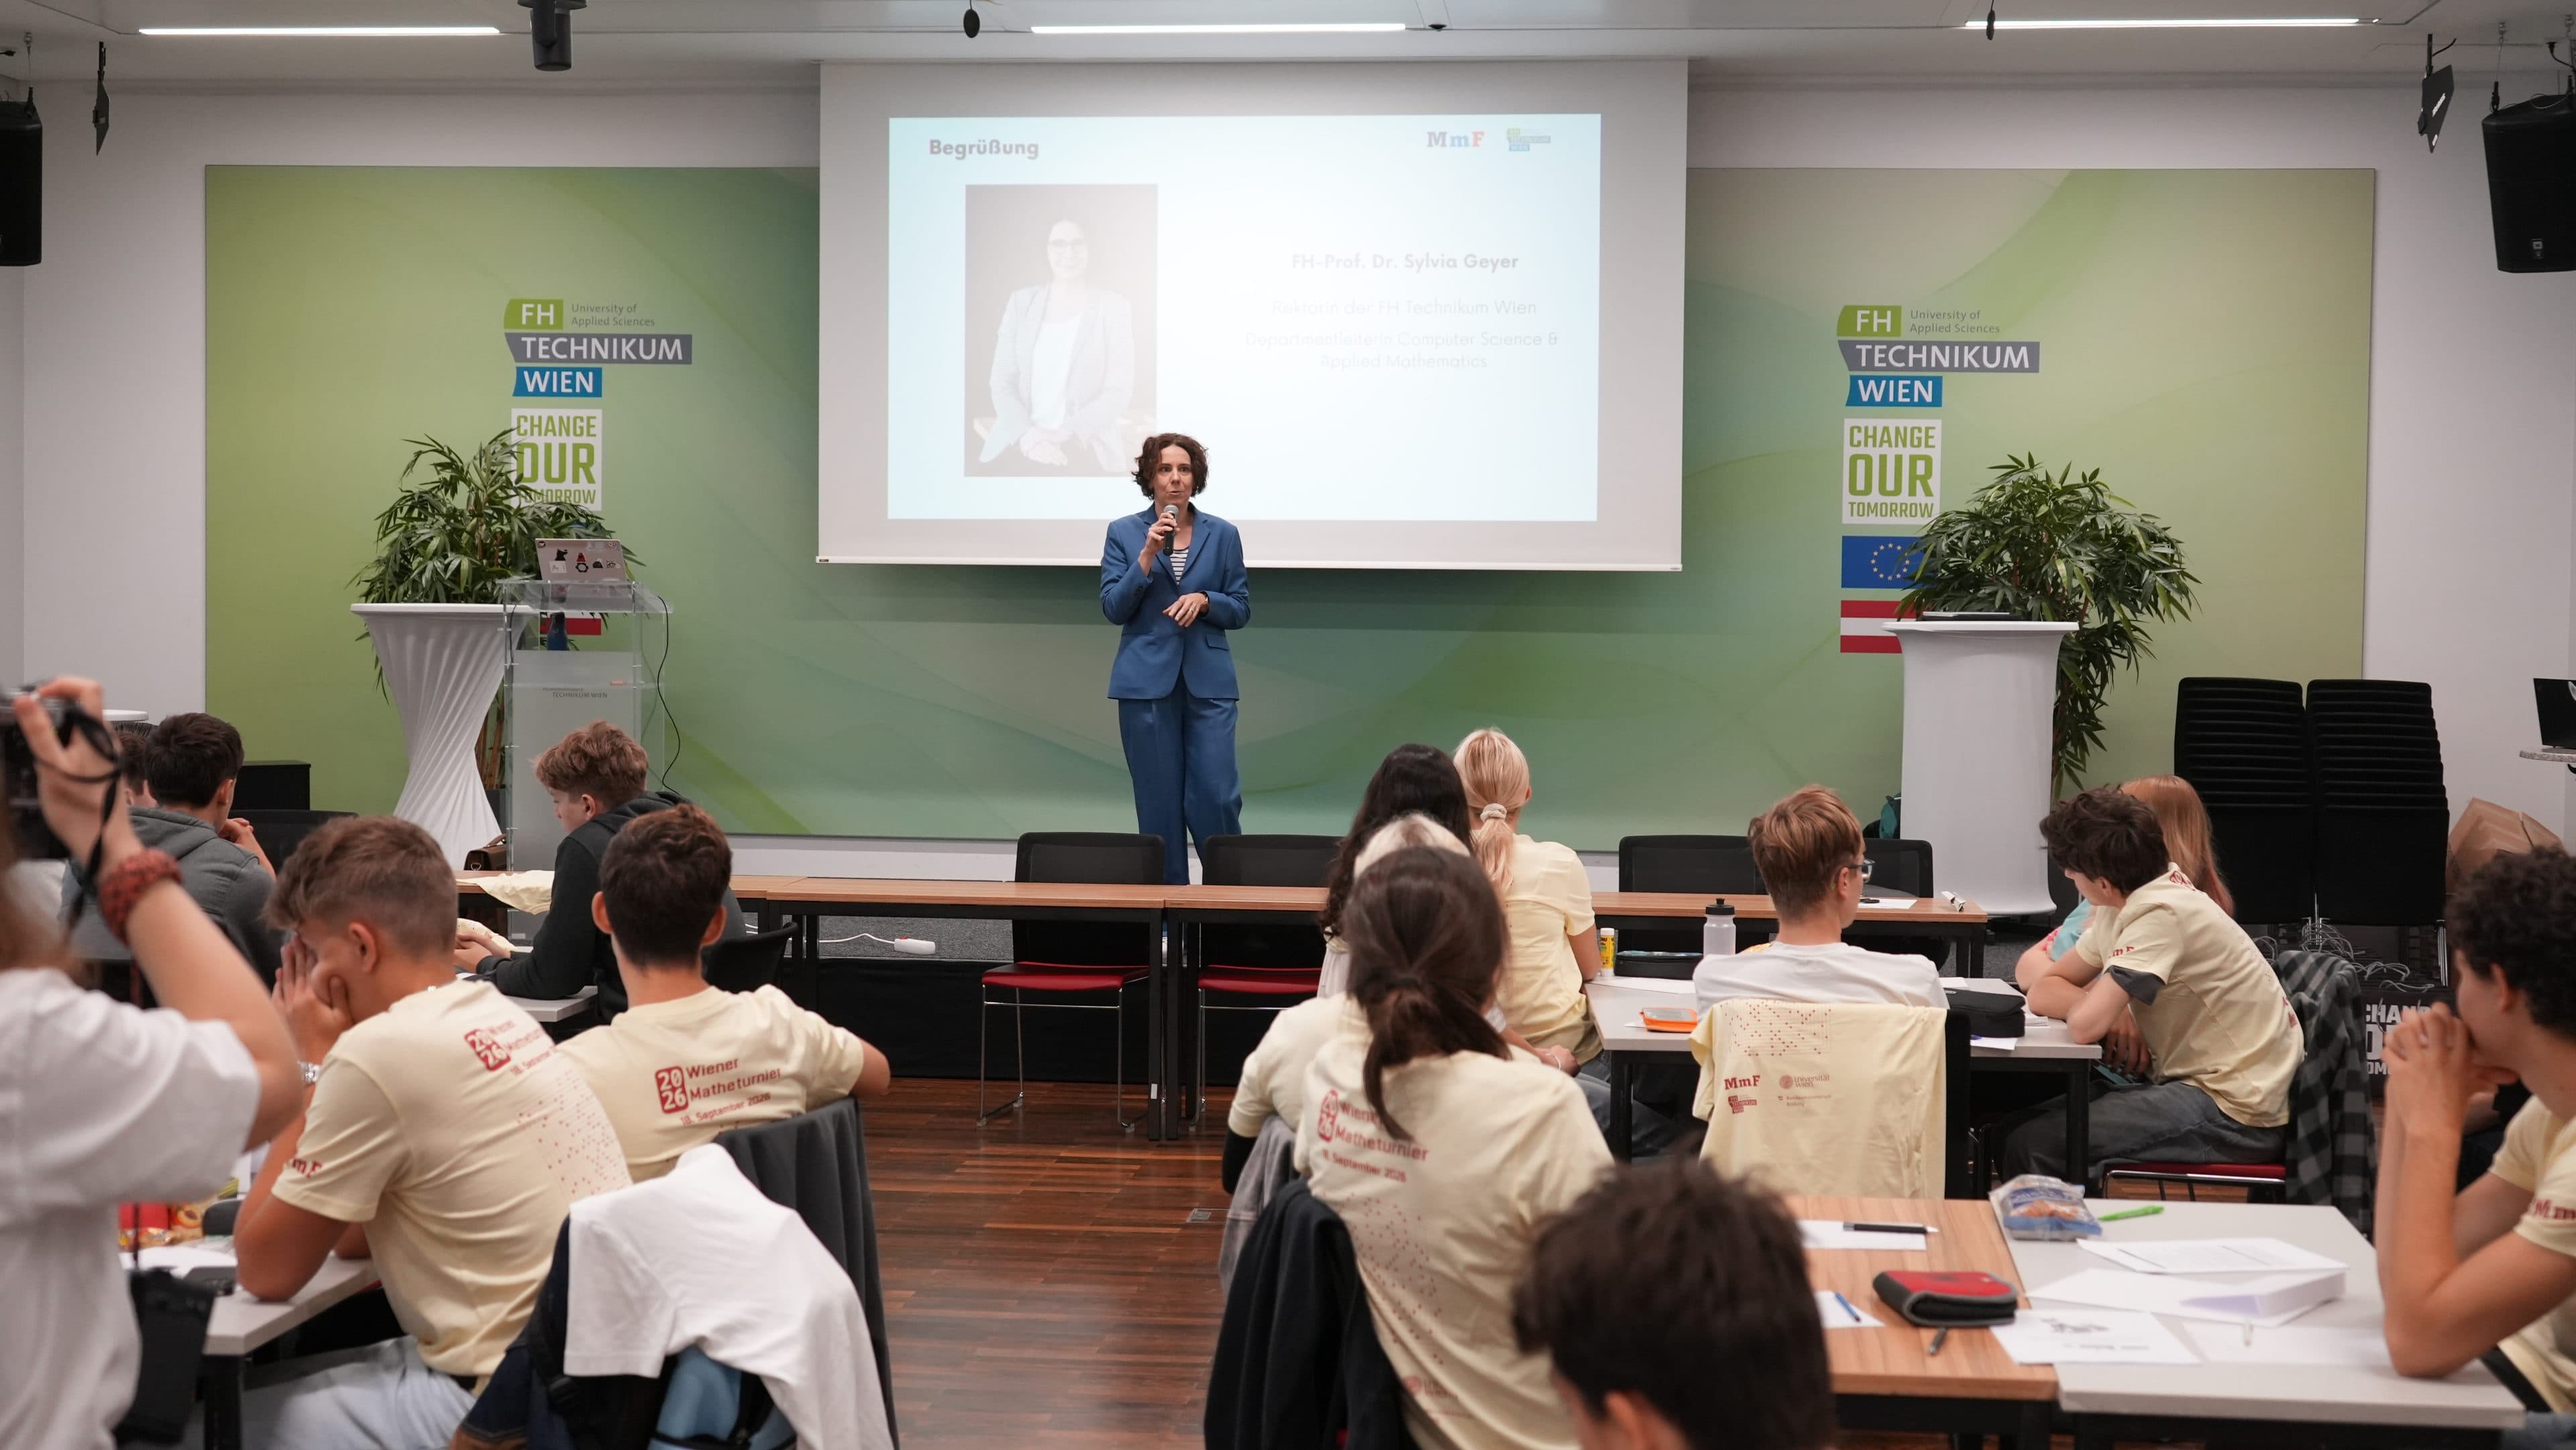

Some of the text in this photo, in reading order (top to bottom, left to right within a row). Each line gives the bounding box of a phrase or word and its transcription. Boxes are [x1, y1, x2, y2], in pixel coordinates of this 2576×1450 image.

[929, 139, 1039, 160] Begrüßung
[1427, 131, 1485, 148] MmF
[1291, 252, 1519, 273] FH-Prof. Dr. Sylvia Geyer
[521, 303, 554, 325] FH
[572, 303, 637, 314] University of
[1379, 300, 1400, 314] FH
[1406, 295, 1489, 314] Technikum
[1495, 299, 1538, 314] Wien
[1911, 309, 1981, 321] University of
[571, 316, 655, 328] Applied Sciences
[1856, 310, 1892, 333] FH
[1910, 323, 2000, 335] Applied Sciences
[521, 337, 683, 360] TECHNIKUM
[1397, 331, 1476, 348] Computer
[1481, 331, 1543, 346] Science
[1548, 331, 1558, 346] &
[1387, 352, 1487, 368] Mathematics
[1856, 344, 2029, 368] TECHNIKUM
[523, 370, 593, 393] WIEN
[1858, 379, 1933, 403] WIEN
[517, 415, 596, 437] CHANGE
[1849, 425, 1936, 448] CHANGE
[516, 442, 596, 484] OUR
[1848, 454, 1934, 497] OUR
[1848, 502, 1934, 518] TOMORROW
[467, 1031, 493, 1051] 20
[480, 1045, 508, 1068] 26
[685, 1057, 739, 1080] Wiener
[657, 1070, 683, 1092] 20
[690, 1068, 782, 1101] Matheturnier
[1724, 1075, 1761, 1090] MmF
[661, 1090, 688, 1110] 26
[695, 1100, 745, 1122] September
[747, 1092, 771, 1107] 2026
[1335, 1125, 1429, 1161] Matheturnier
